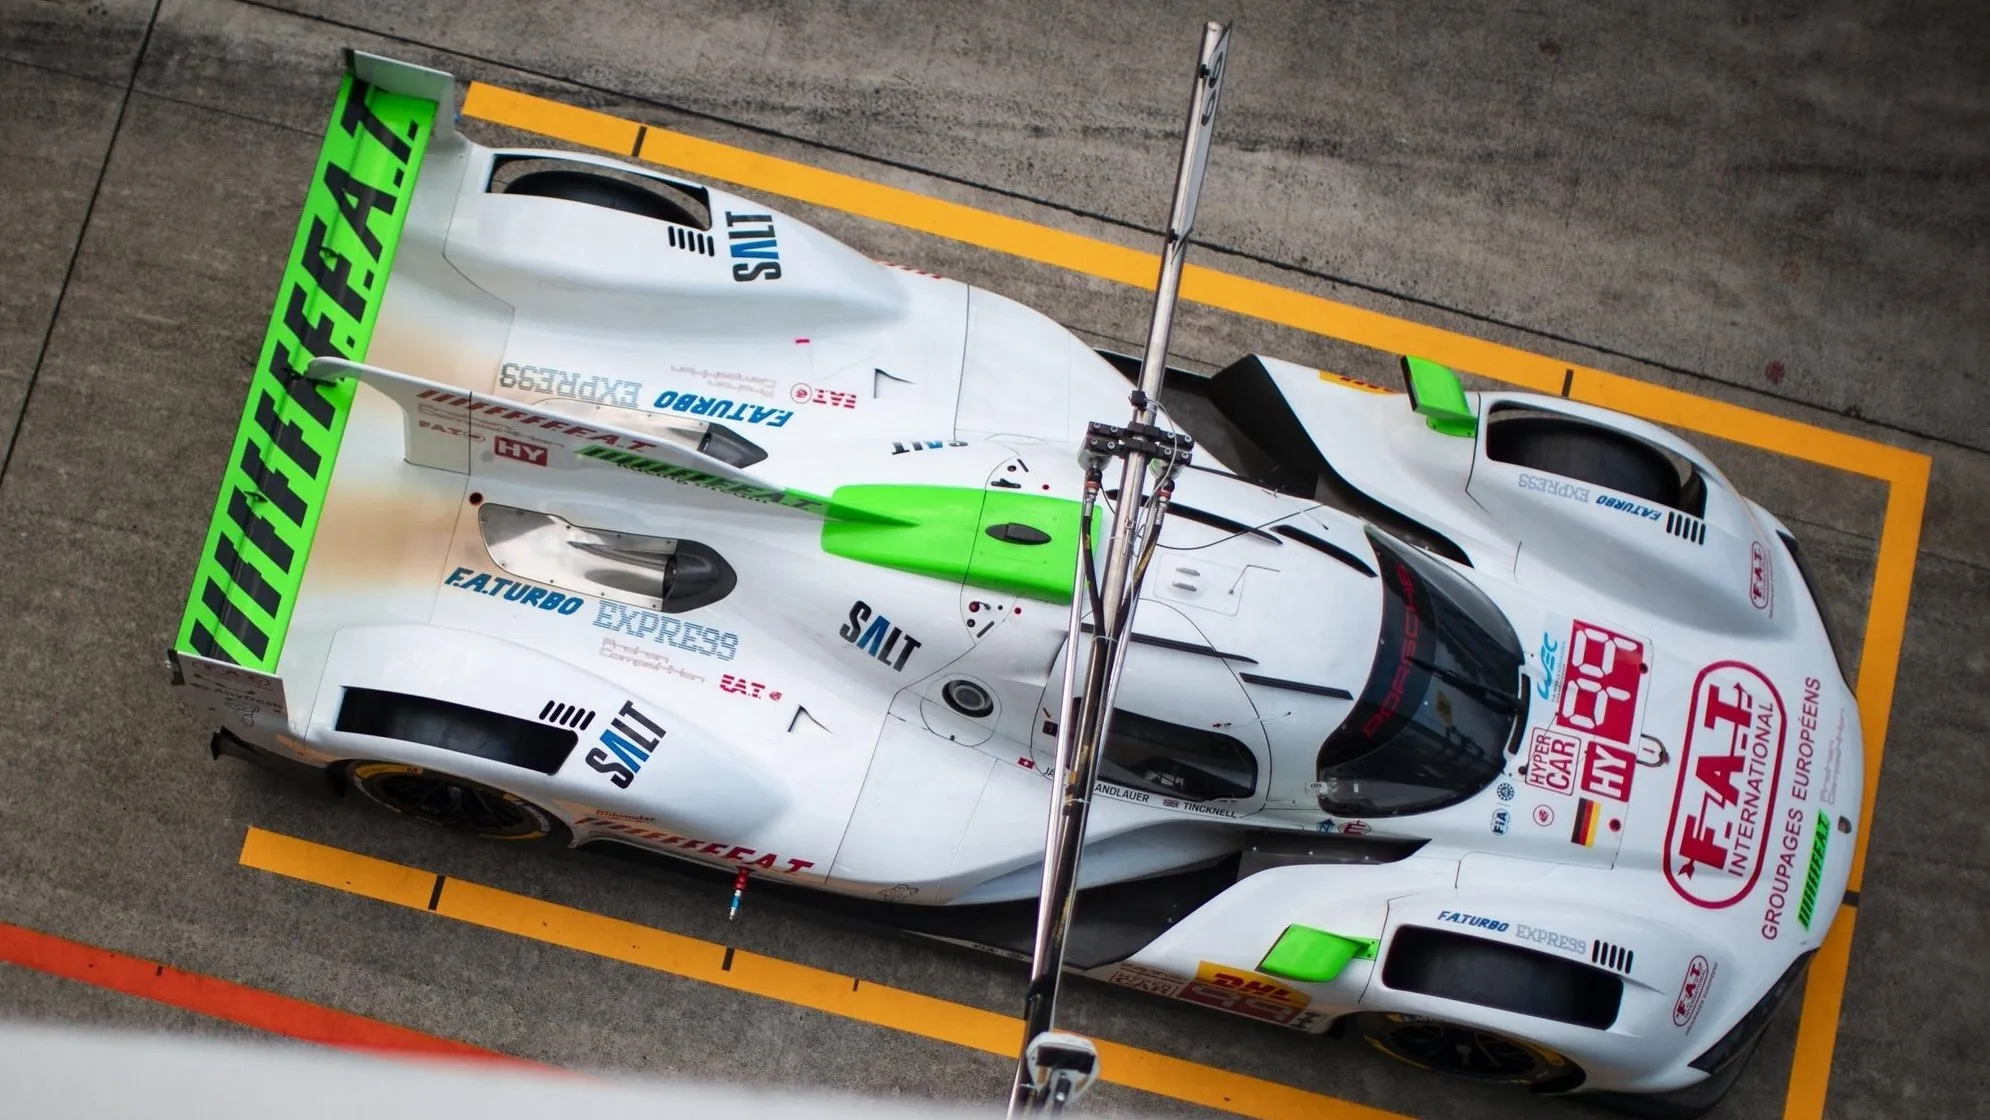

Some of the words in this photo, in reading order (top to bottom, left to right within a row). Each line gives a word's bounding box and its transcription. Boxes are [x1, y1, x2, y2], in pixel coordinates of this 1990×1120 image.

[498, 440, 545, 462] HY
[839, 600, 922, 673] SALT
[1362, 561, 1420, 740] PORSCHE
[1536, 631, 1559, 700] WEC
[1562, 628, 1639, 730] 99
[585, 699, 667, 790] SALT
[1529, 734, 1552, 786] HYPER
[1545, 738, 1577, 791] CAR
[1589, 744, 1628, 799] HY
[1183, 801, 1238, 819] TINCKNELL
[1728, 701, 1775, 878] INTERNATIONAL
[1761, 807, 1804, 941] GROUPAGES
[1791, 676, 1821, 801] EUROPÉENS
[1212, 972, 1297, 1001] DHL
